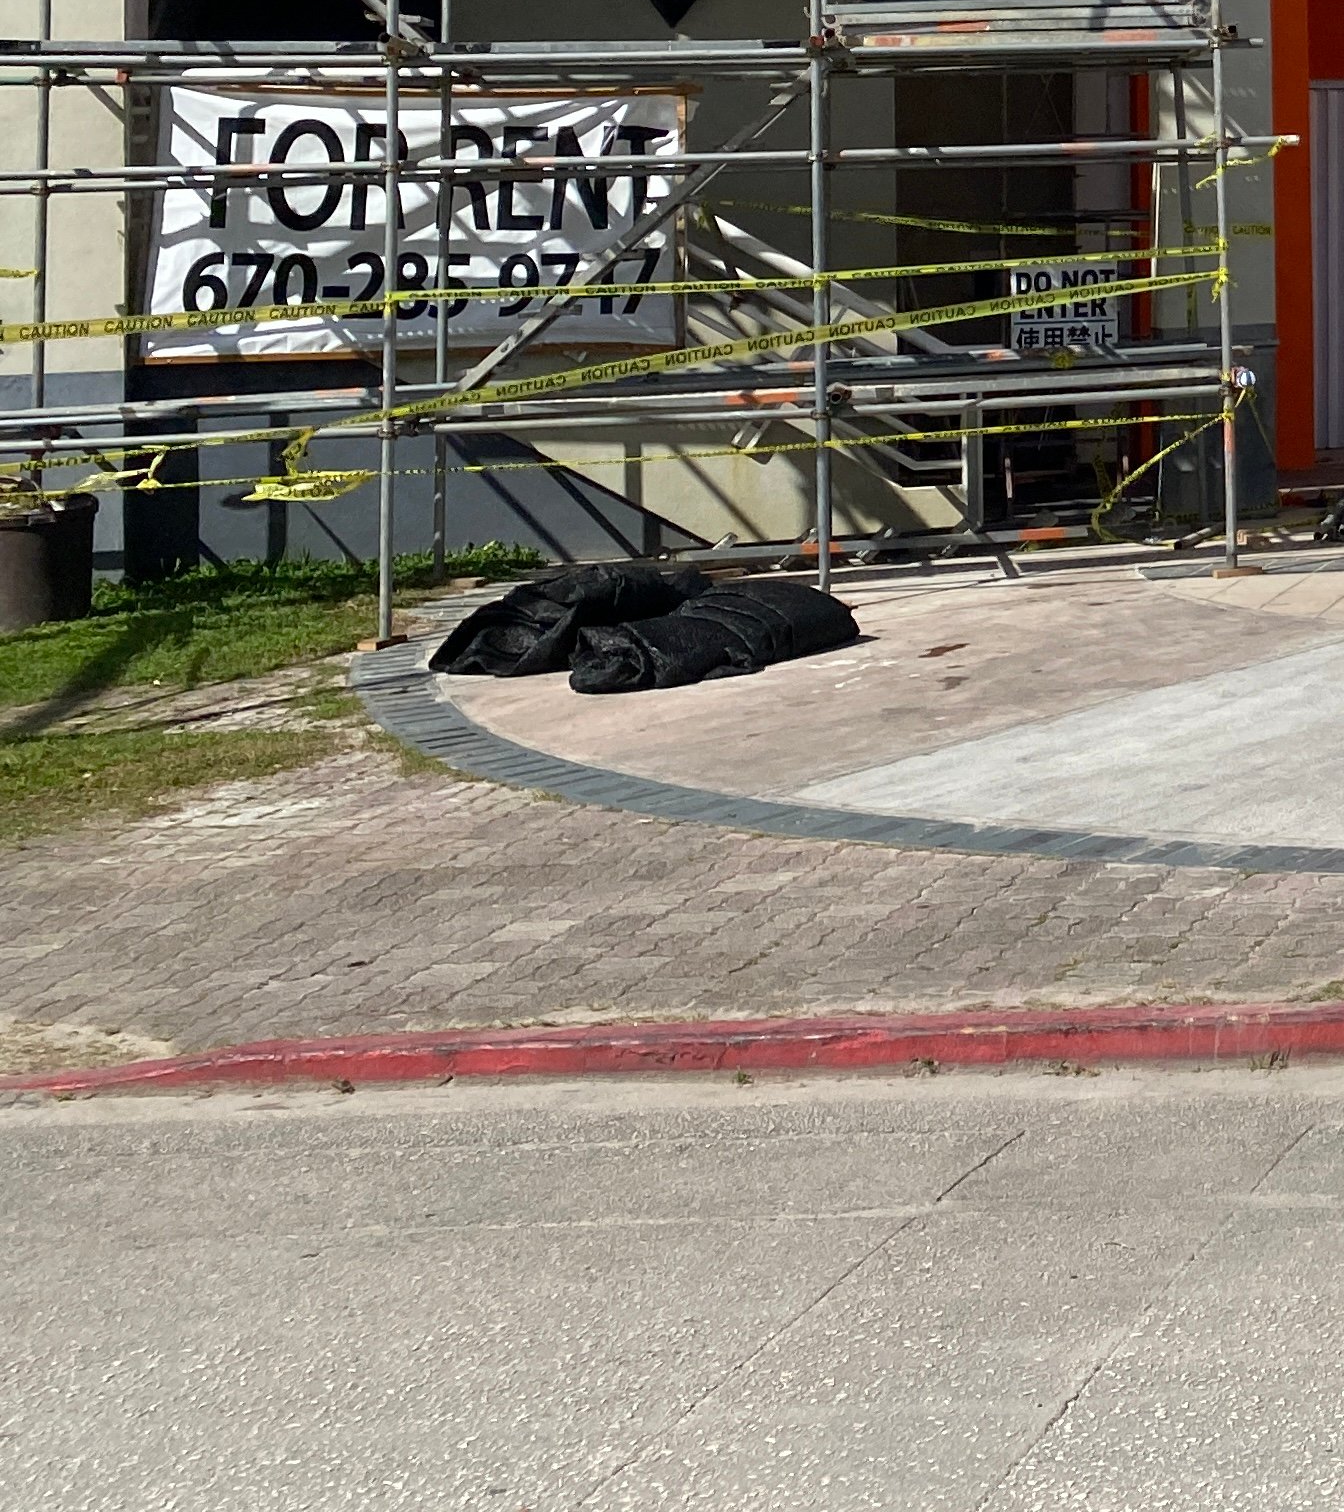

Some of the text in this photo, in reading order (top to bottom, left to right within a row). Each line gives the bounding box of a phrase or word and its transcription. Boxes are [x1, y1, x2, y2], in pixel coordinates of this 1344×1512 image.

[209, 116, 669, 232] FOR RENT
[585, 284, 656, 295] CAUTION
[671, 281, 741, 292] CAUTION
[1016, 269, 1116, 295] DO NOT
[19, 301, 390, 340] CAUTION CAUTION CAUTION CAUTION CAUT
